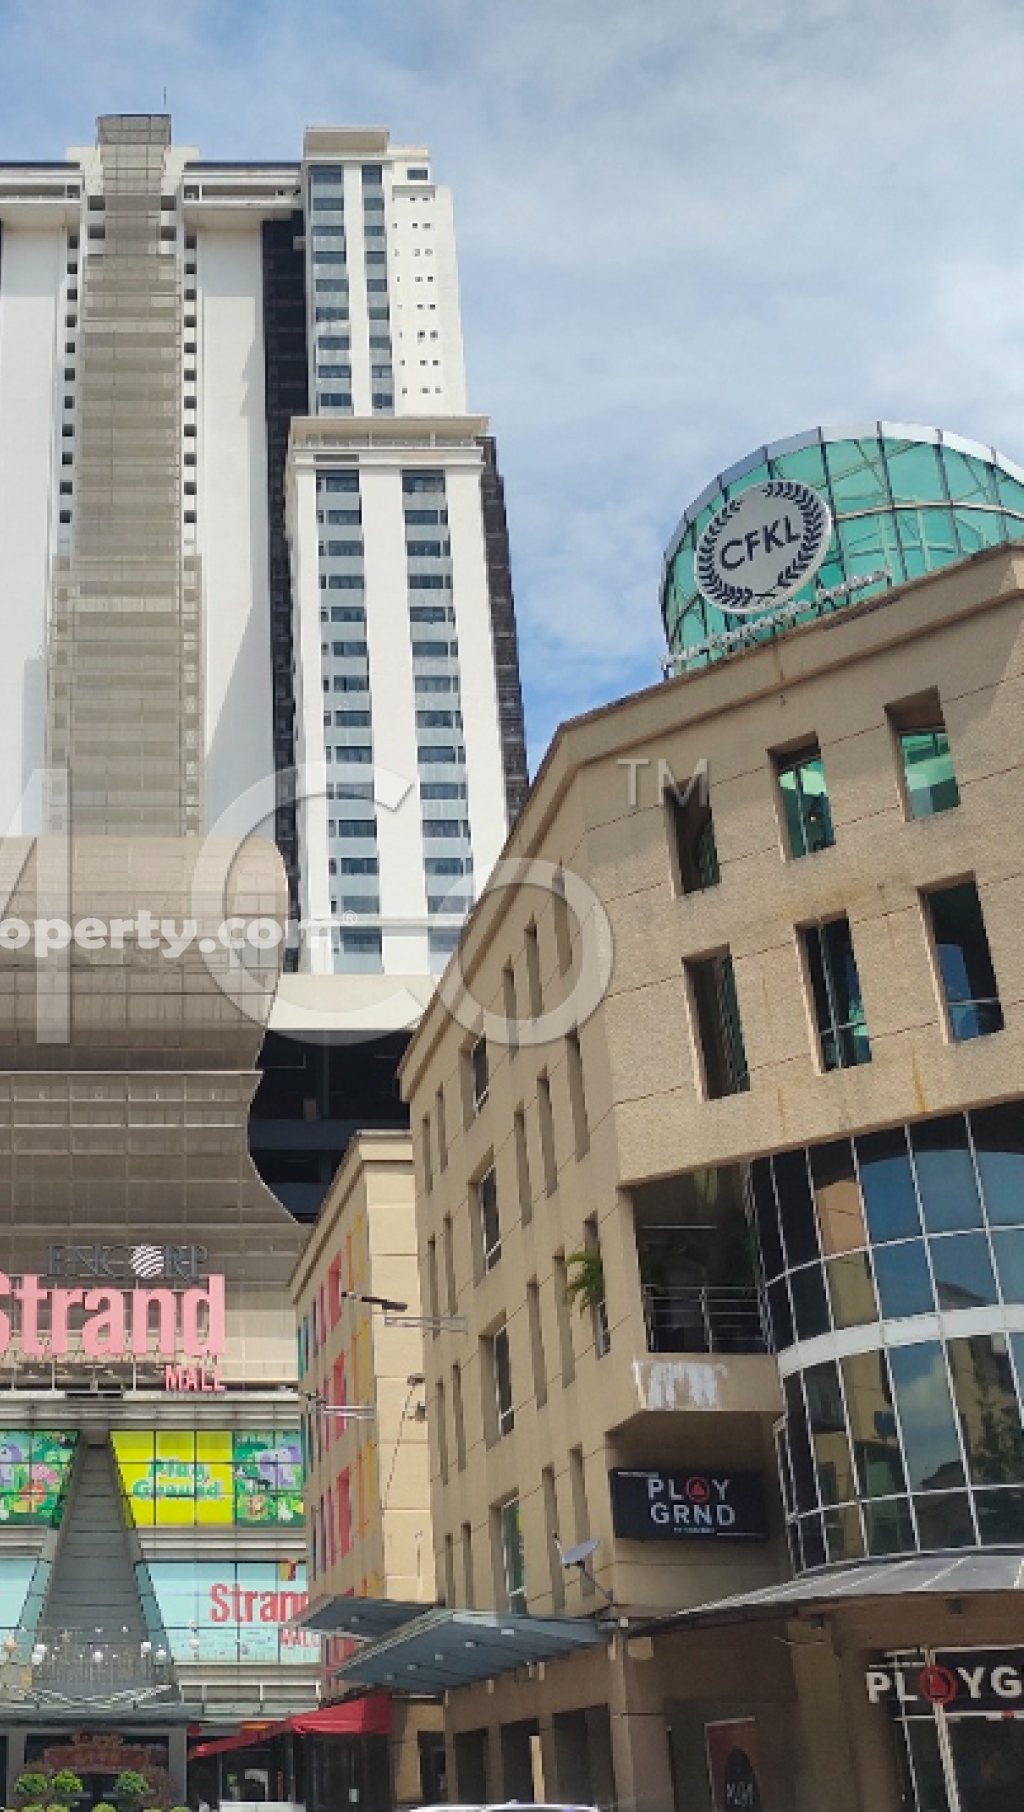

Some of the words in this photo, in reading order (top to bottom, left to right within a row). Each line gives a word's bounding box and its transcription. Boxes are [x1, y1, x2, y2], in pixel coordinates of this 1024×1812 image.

[719, 514, 803, 571] CFKL
[165, 1363, 226, 1392] MALL
[650, 1502, 736, 1526] GRND
[209, 1582, 309, 1623] Stran
